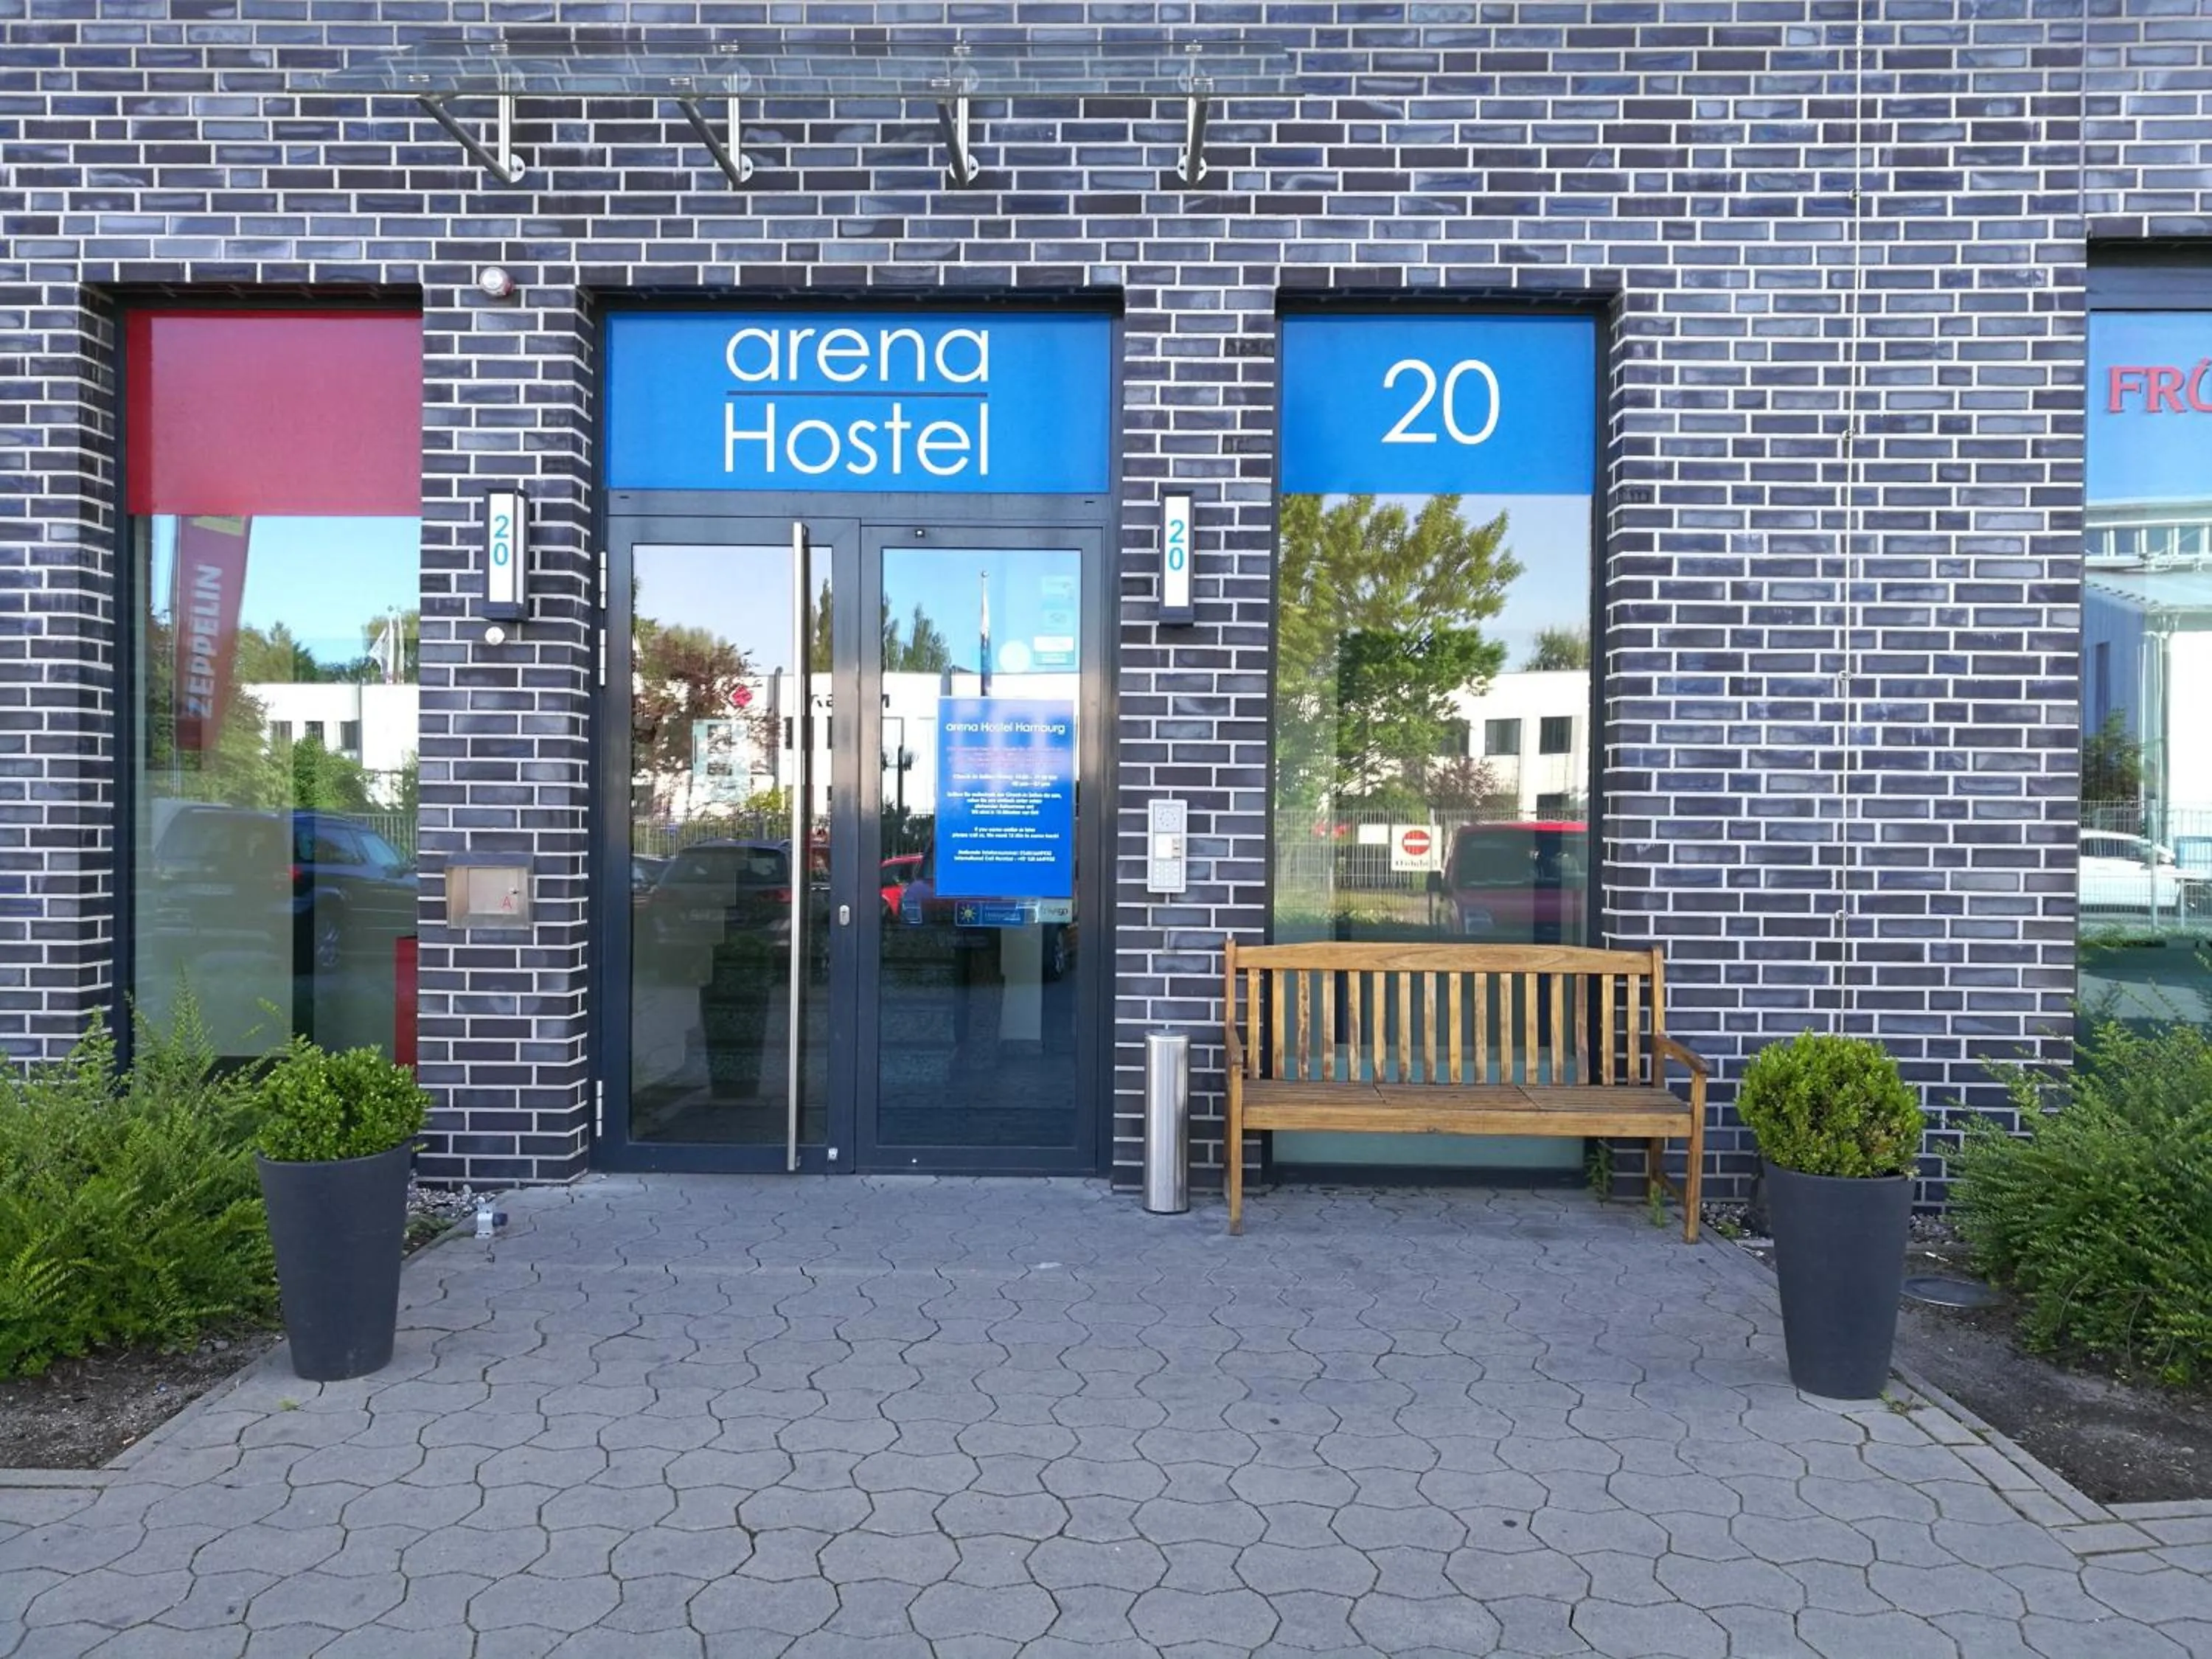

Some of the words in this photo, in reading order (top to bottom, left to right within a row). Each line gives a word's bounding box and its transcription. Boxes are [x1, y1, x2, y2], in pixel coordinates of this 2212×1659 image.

[726, 328, 989, 383] arena
[725, 402, 989, 476] Hostel
[1381, 359, 1500, 445] 20
[186, 564, 223, 719] ZEPPELIN
[946, 722, 978, 732] arena
[981, 722, 1013, 732] Hostel
[1015, 723, 1065, 735] Hamburg
